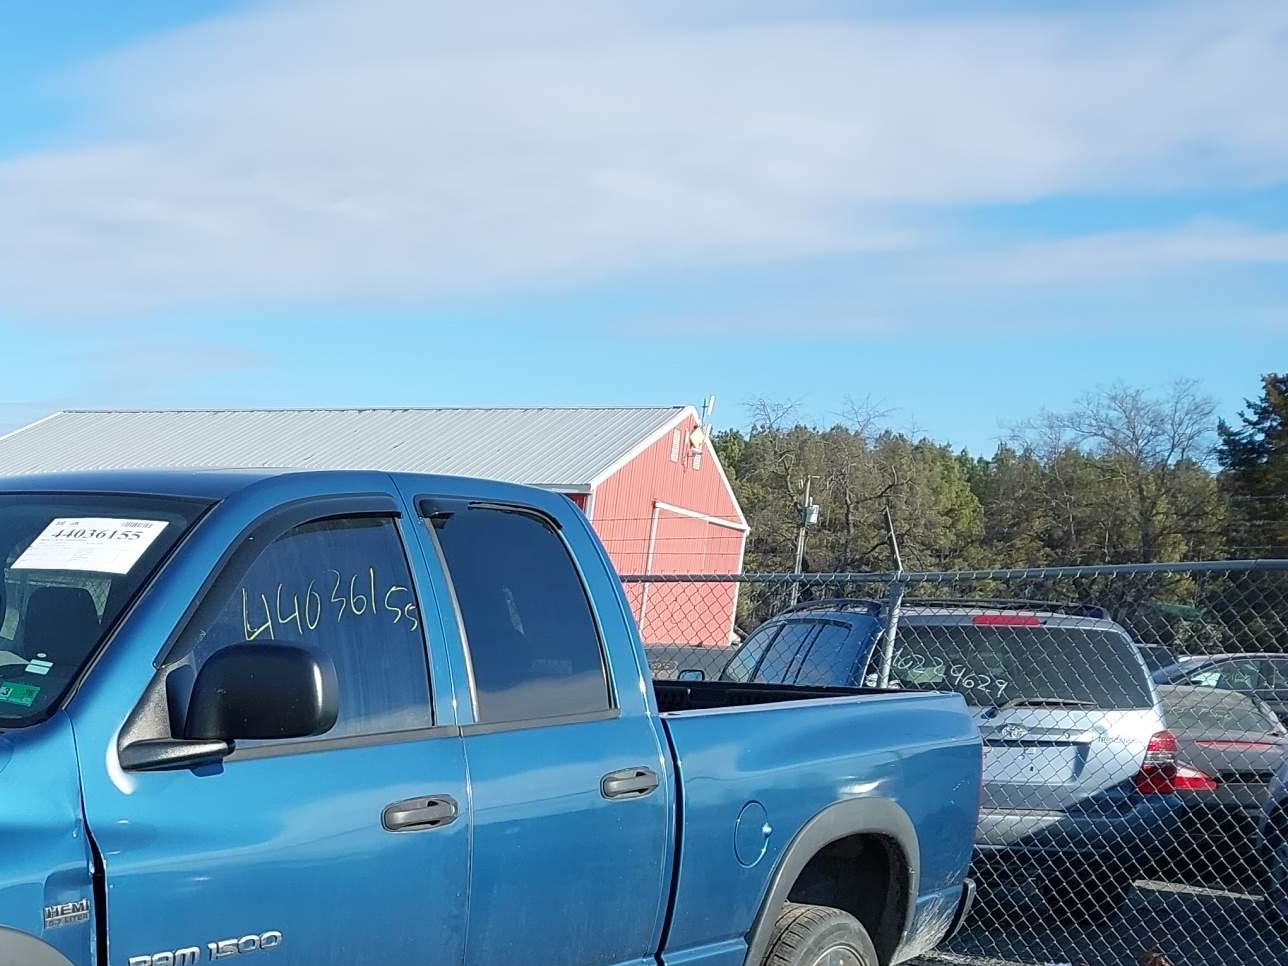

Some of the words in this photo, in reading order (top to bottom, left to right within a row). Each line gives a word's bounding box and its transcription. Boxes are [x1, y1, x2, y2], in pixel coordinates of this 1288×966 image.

[51, 528, 144, 541] 44036155
[242, 567, 418, 641] 44036155
[45, 898, 89, 919] HEMI
[208, 930, 283, 961] 1500
